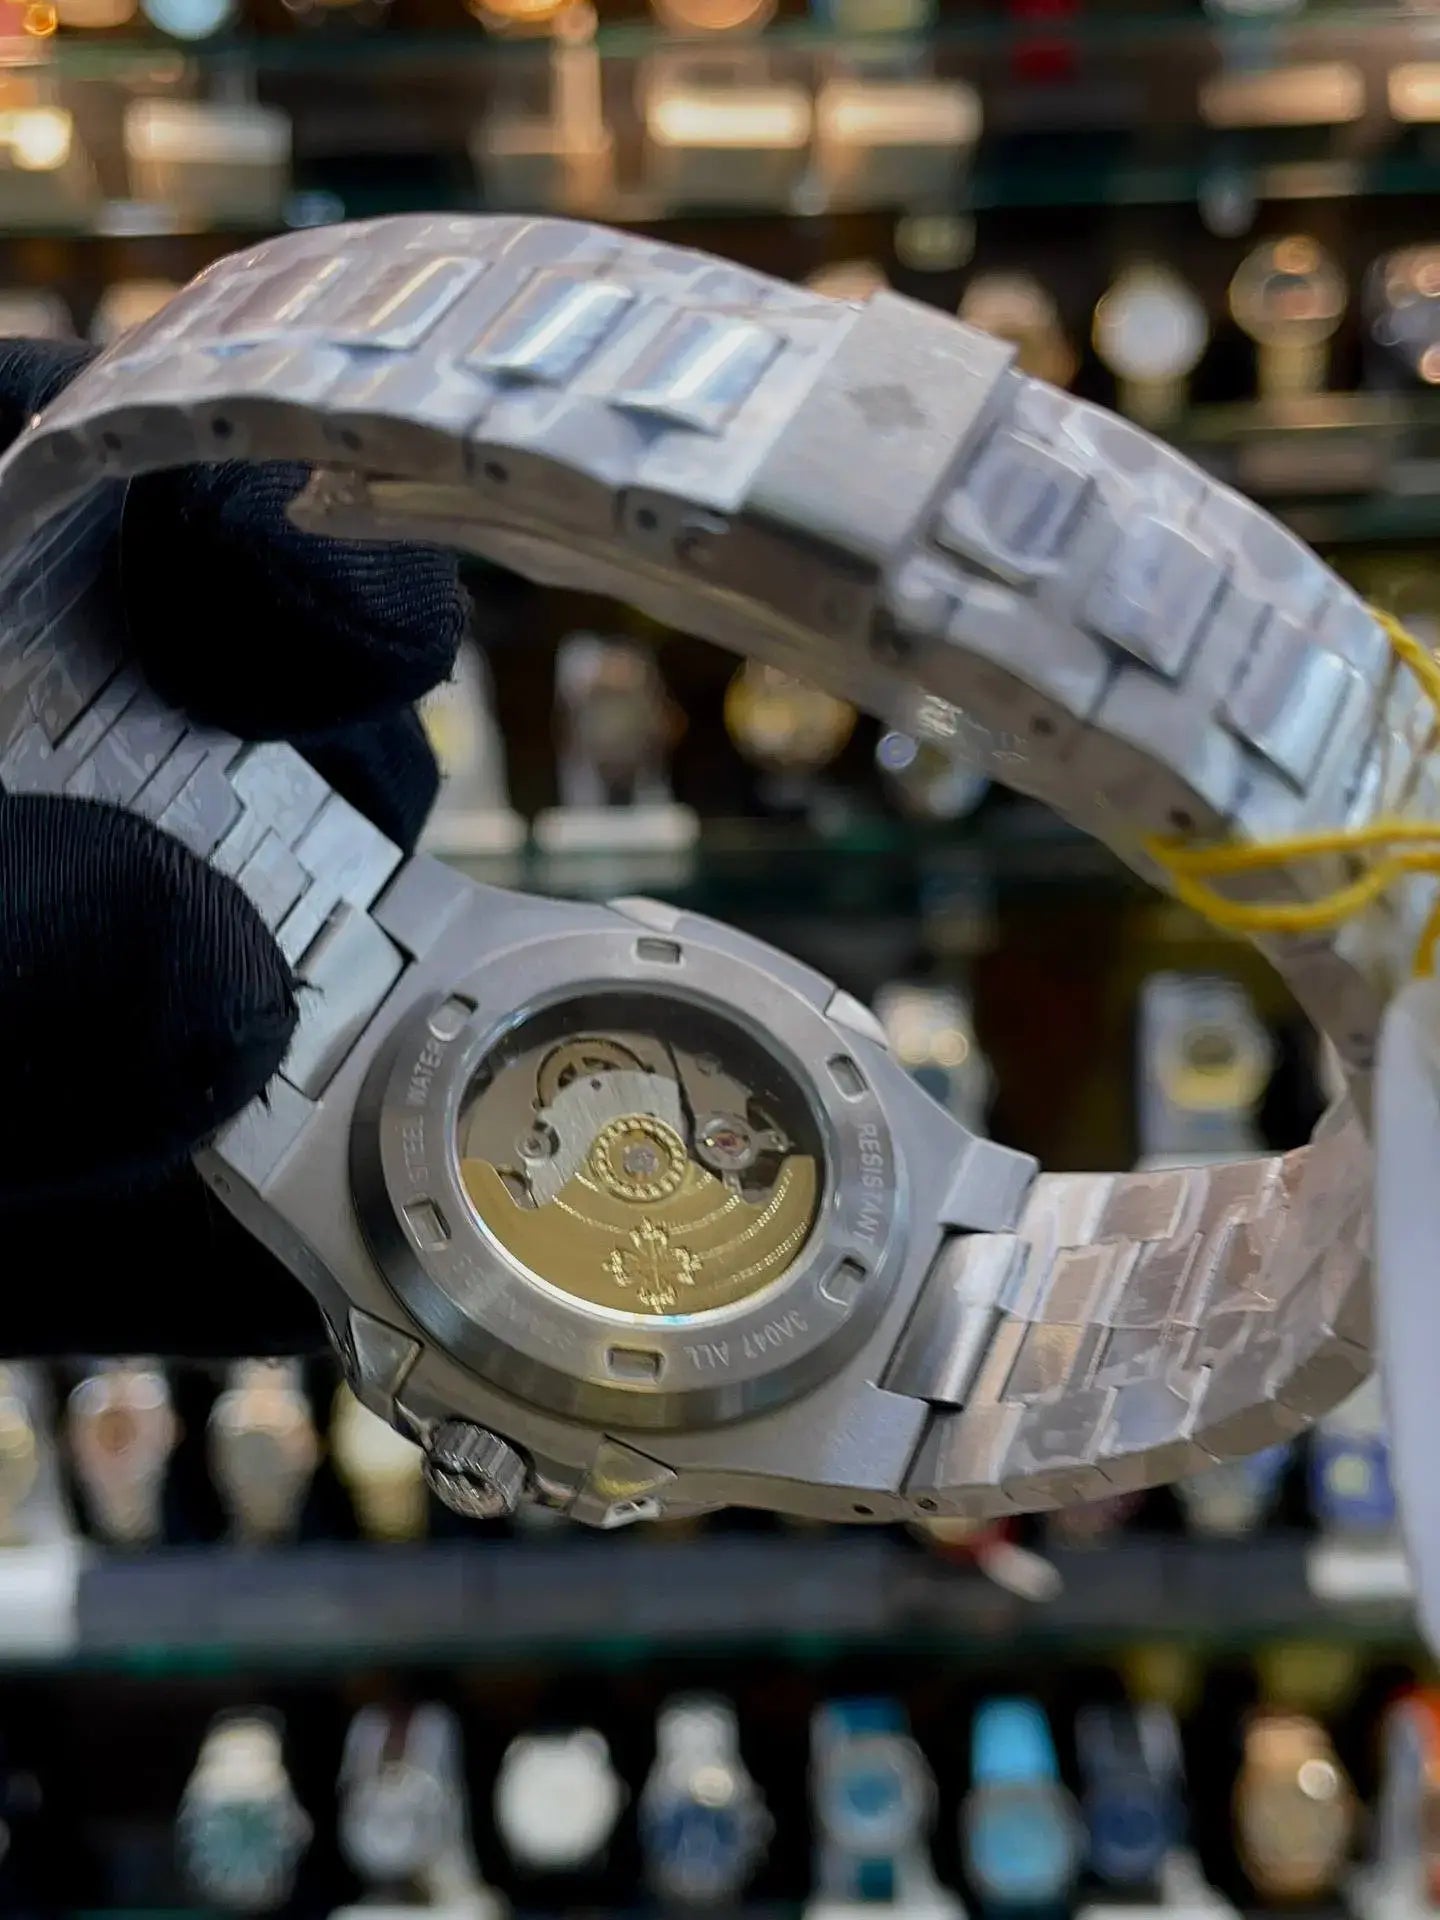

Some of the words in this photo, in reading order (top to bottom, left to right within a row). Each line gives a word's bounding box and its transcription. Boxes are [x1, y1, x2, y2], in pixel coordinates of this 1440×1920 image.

[407, 1038, 448, 1106] WATER
[403, 1115, 429, 1184] STEEL
[852, 1122, 884, 1246] RESISTANT
[682, 1339, 730, 1371] ALL
